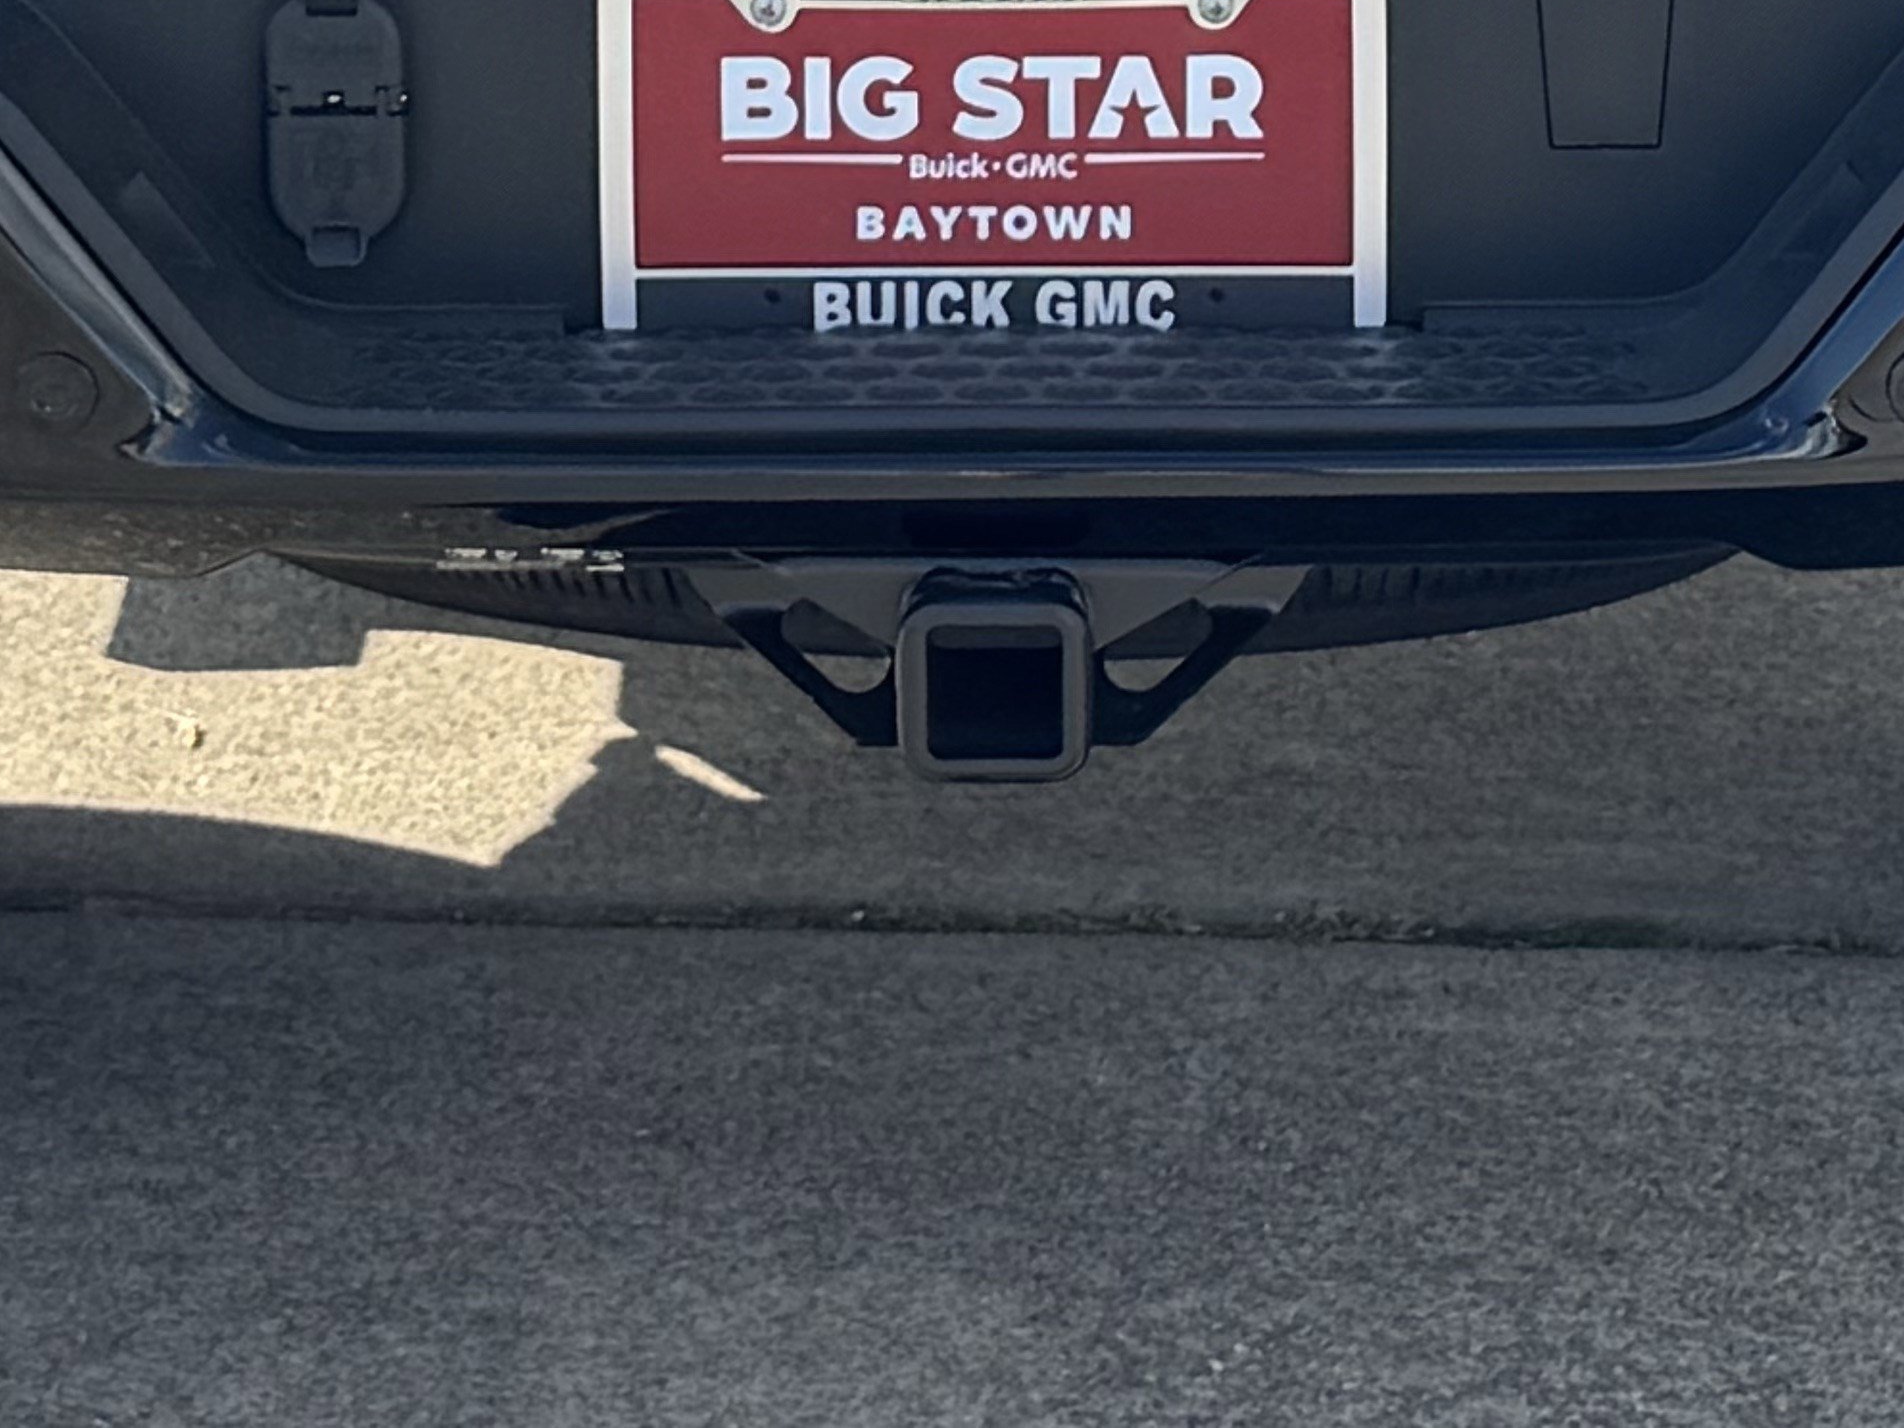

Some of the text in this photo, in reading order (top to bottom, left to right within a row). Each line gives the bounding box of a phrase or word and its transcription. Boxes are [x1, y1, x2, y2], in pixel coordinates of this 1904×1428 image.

[720, 54, 1264, 141] BIG STAR
[909, 152, 1078, 179] Buick GMC
[855, 205, 1133, 240] BAYTOWN
[813, 280, 1176, 332] BUICK GMC
